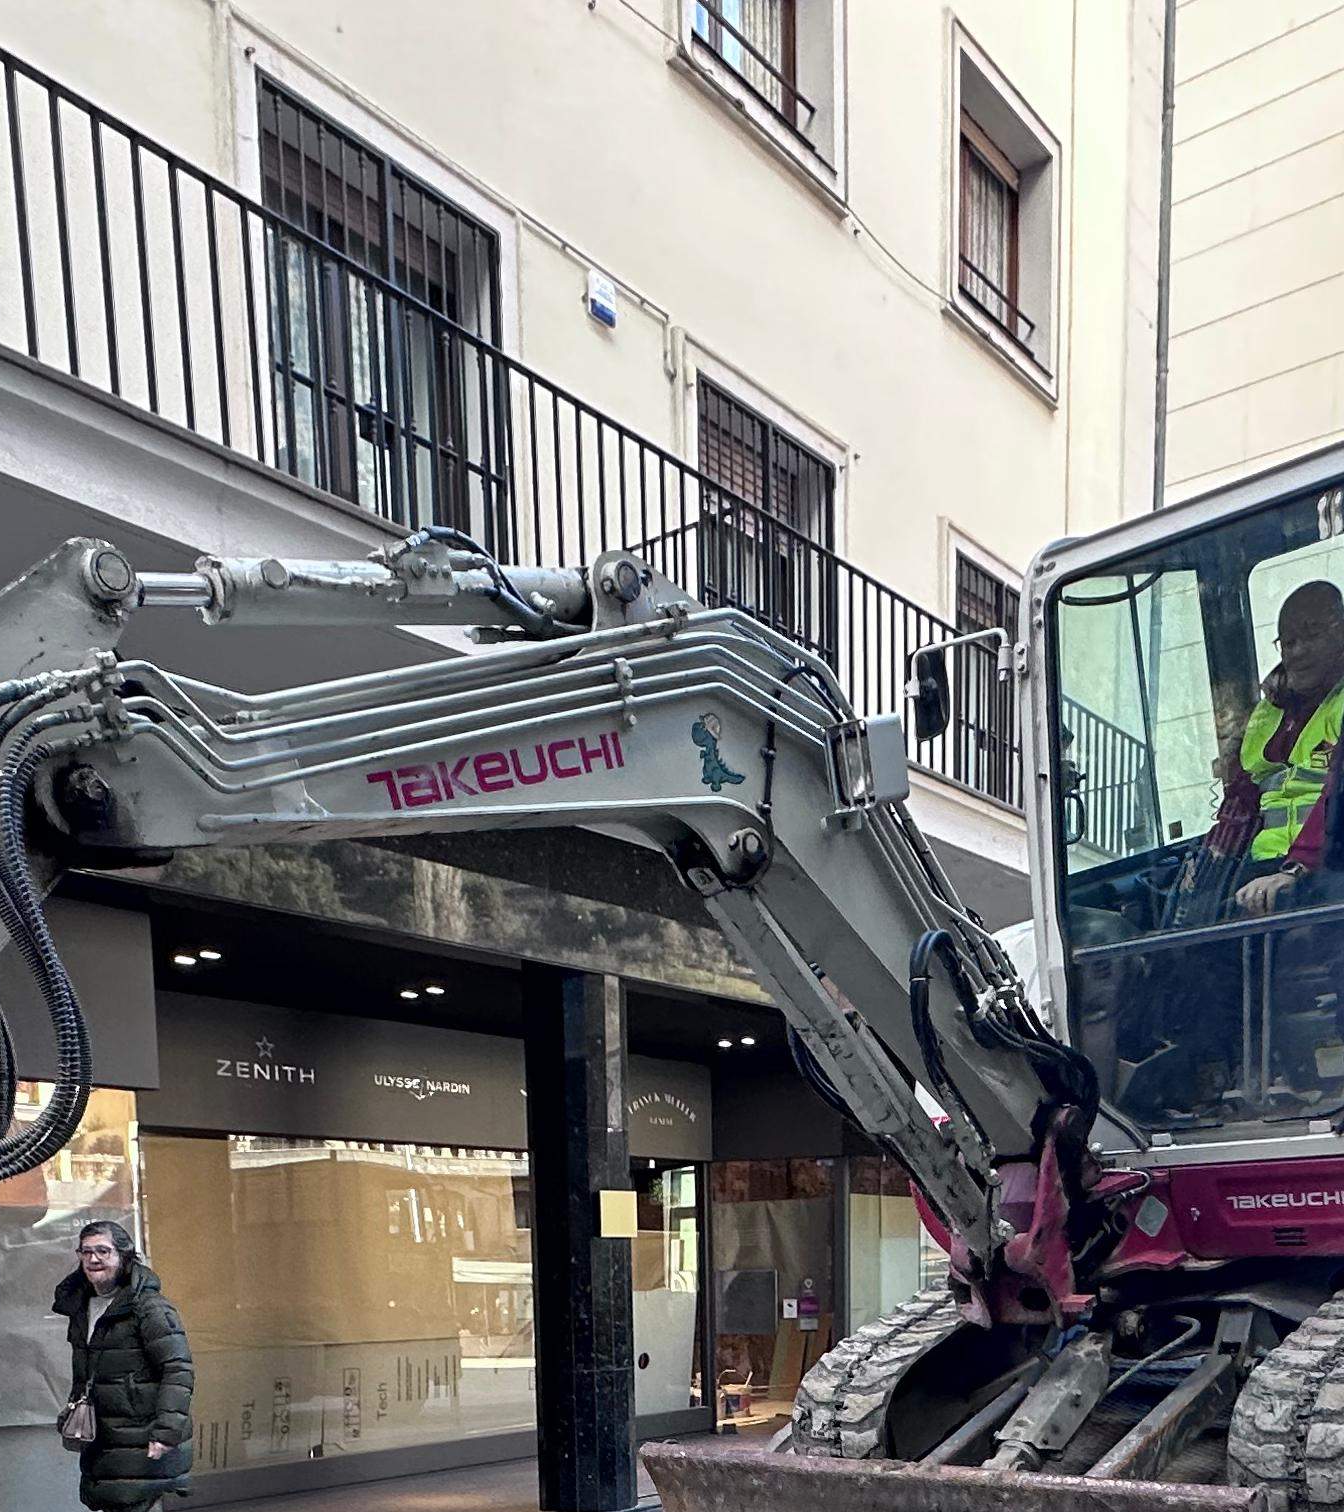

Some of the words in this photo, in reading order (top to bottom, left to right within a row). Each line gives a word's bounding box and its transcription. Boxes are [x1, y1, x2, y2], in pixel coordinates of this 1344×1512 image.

[216, 1059, 316, 1085] ZENITH
[374, 1074, 421, 1089] ULYSSE
[426, 1080, 471, 1095] NARDIN
[375, 1382, 389, 1422] Tech
[241, 1399, 256, 1441] Tech
